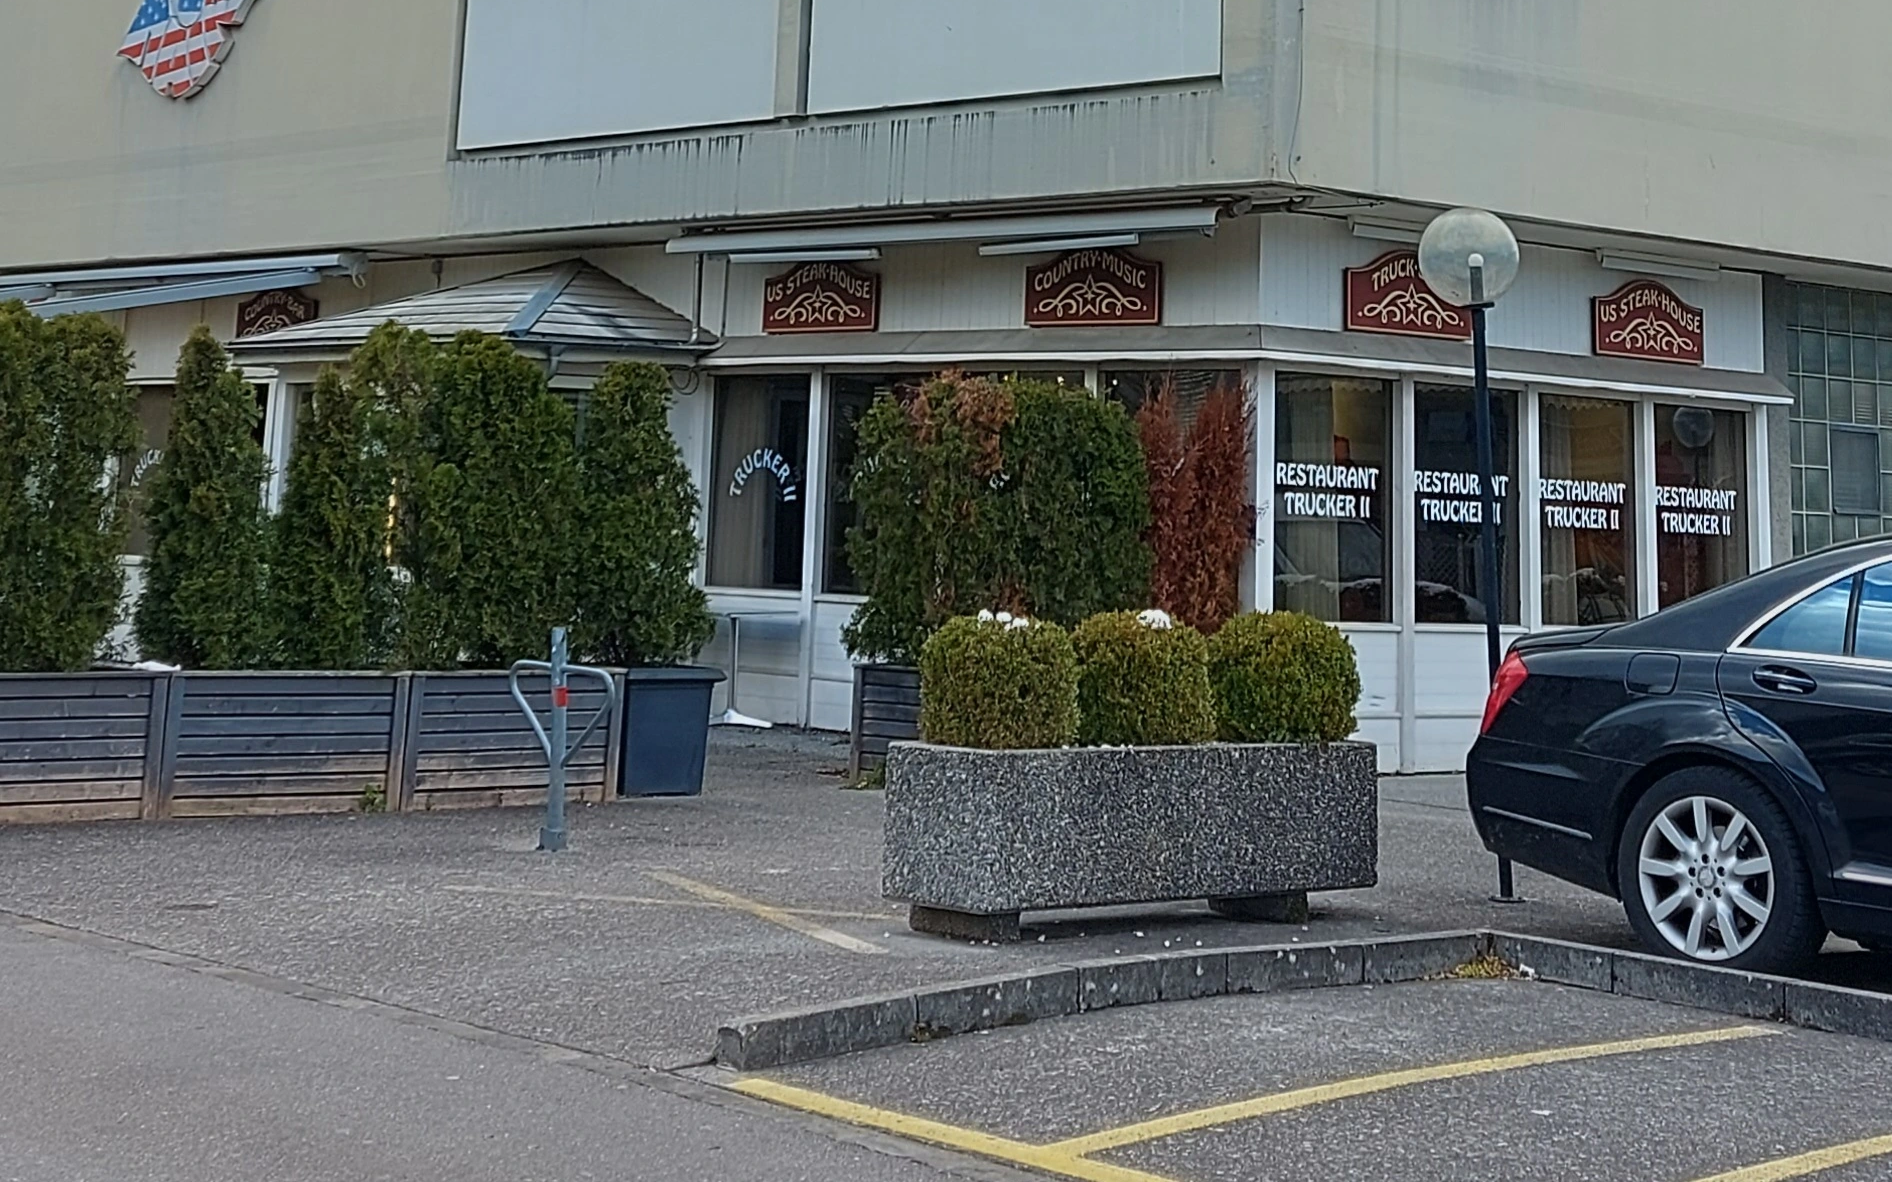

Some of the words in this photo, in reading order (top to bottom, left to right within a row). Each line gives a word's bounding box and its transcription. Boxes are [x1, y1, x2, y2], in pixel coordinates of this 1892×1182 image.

[767, 283, 783, 302] US
[1601, 304, 1617, 322] US
[729, 448, 790, 496] TRUCKER
[1276, 462, 1379, 491] RESTAURANT
[1415, 471, 1509, 497] RESTAURNT
[1540, 479, 1626, 504] RESTAURANT
[1656, 485, 1737, 510] RESTAURANT
[1284, 491, 1356, 518] TRUCKER
[1544, 505, 1607, 529] TRUCKER
[1661, 511, 1720, 535] TRUCKER
